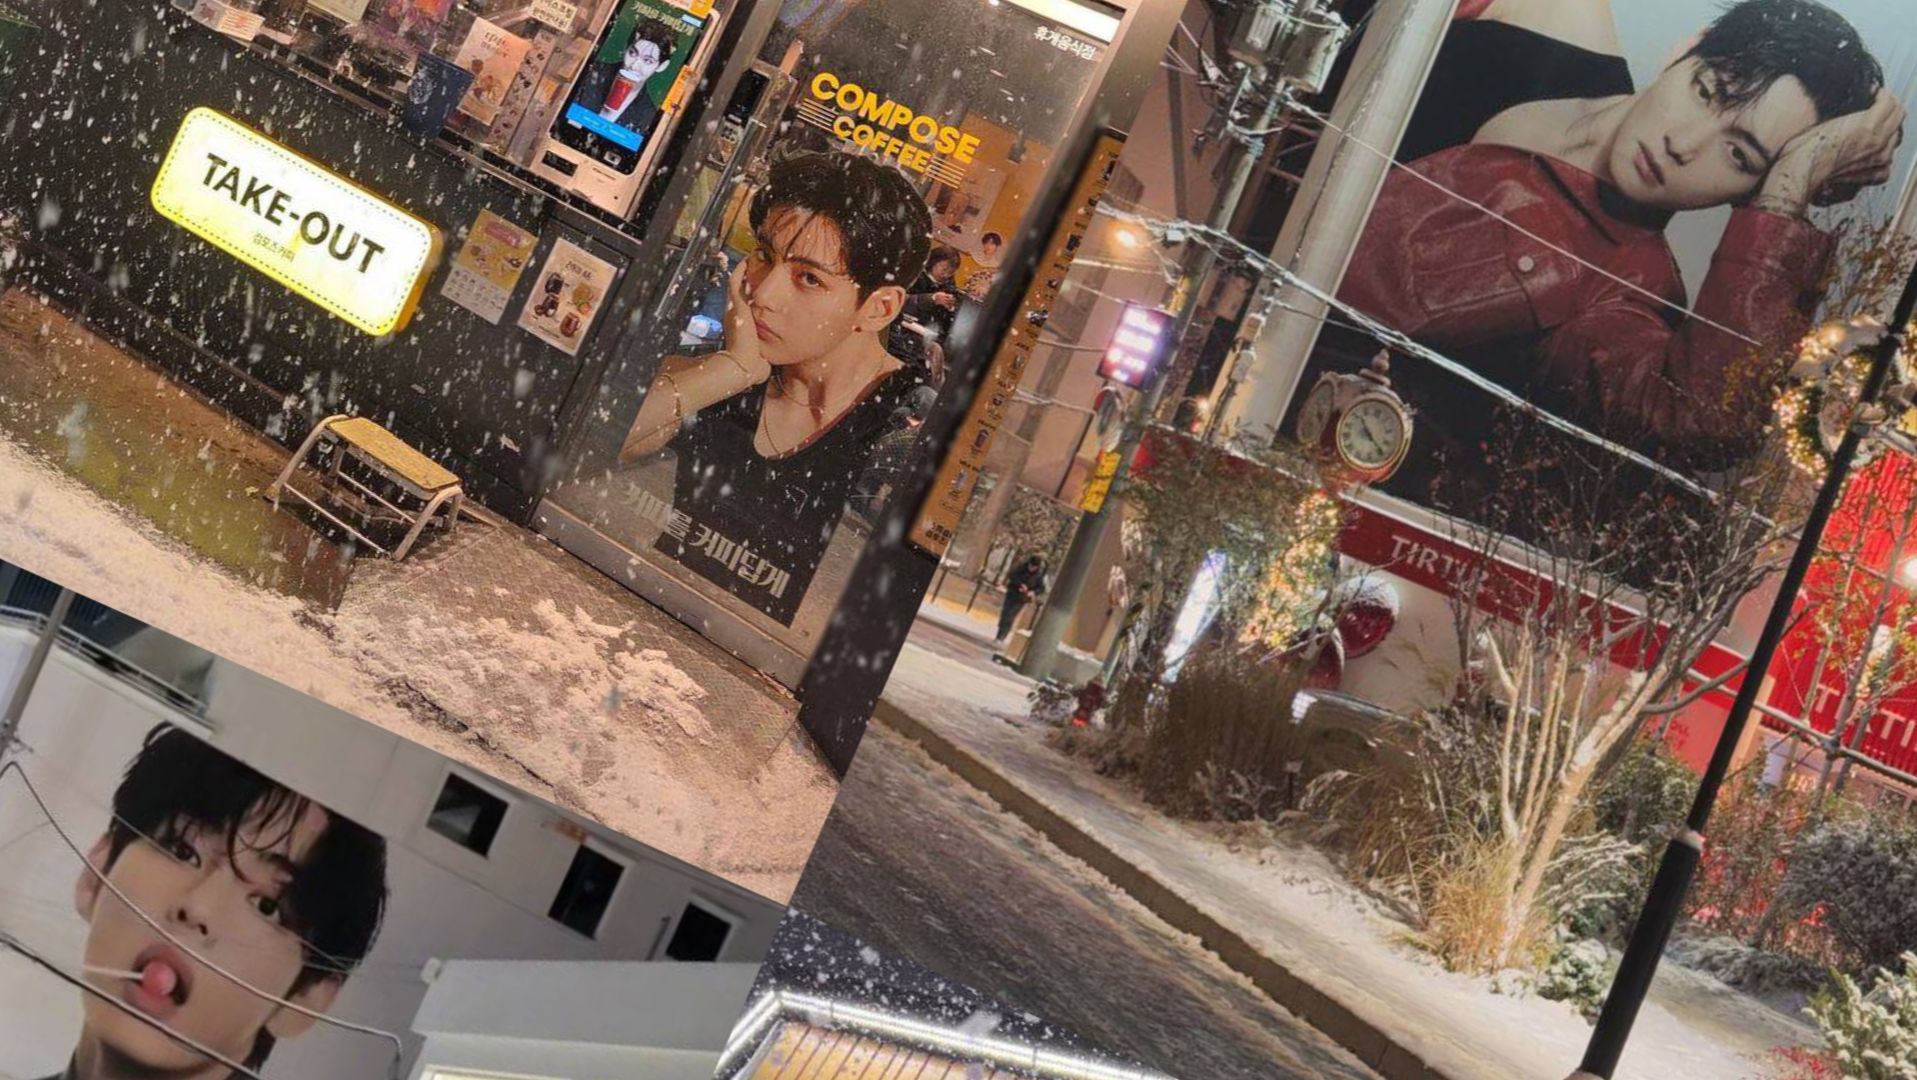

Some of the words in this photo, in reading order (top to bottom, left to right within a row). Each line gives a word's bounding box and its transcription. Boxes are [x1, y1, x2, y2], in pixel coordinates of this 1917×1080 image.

[1034, 25, 1097, 60] 휴게음식점
[811, 72, 981, 164] COMPOSE
[833, 116, 933, 173] COFFEE
[199, 152, 385, 274] TAKE-OUT
[621, 481, 693, 542] 커피를
[690, 523, 791, 599] 커피답게
[1817, 683, 1917, 752] TITI
